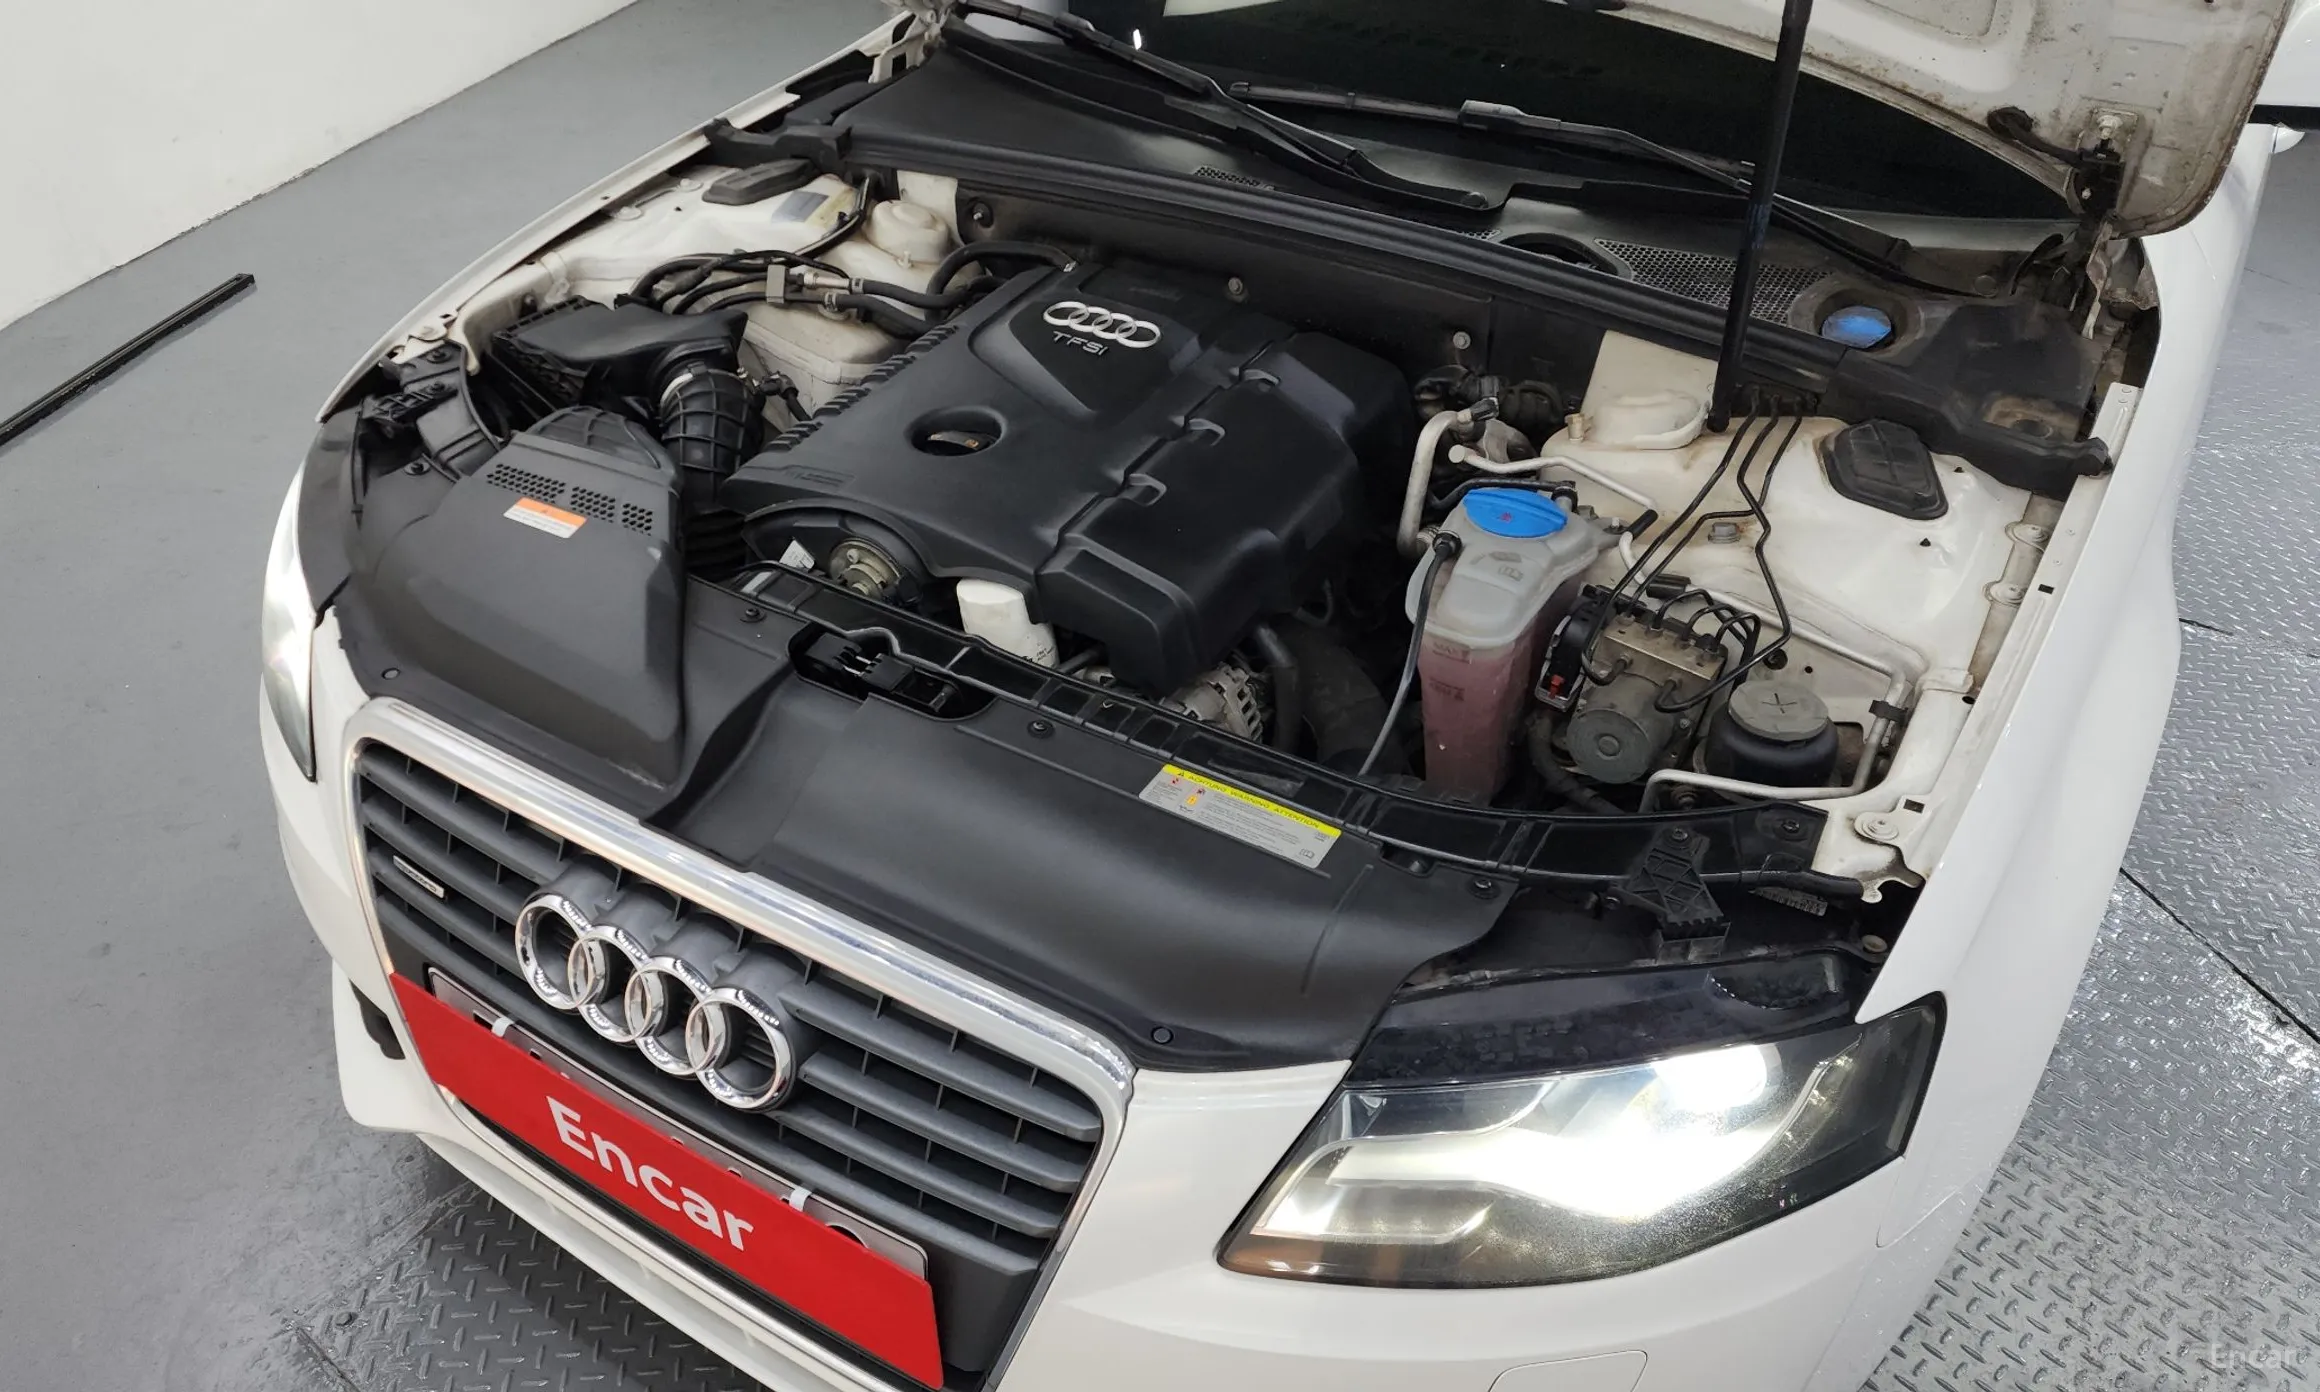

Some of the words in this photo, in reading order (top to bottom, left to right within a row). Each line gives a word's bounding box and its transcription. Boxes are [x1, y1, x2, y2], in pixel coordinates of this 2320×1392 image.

[1053, 331, 1108, 355] TFSI
[1187, 774, 1227, 793] ACHTUNG
[1229, 789, 1270, 808] WARNING
[1273, 806, 1320, 828] ATTENTION
[546, 1095, 756, 1252] Encar
